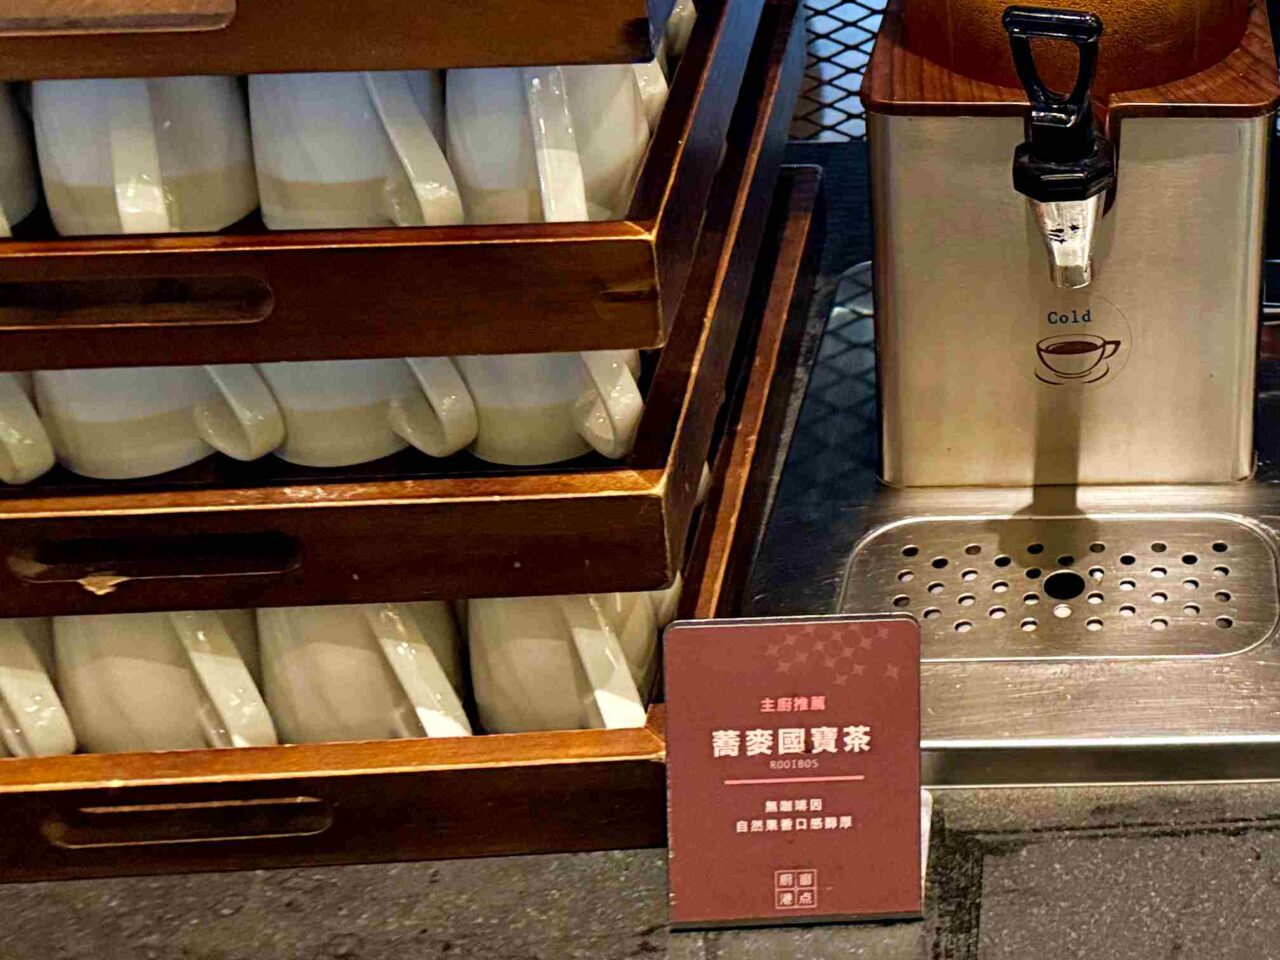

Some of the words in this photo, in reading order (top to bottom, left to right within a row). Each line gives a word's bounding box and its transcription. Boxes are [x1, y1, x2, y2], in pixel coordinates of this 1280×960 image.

[1047, 309, 1092, 325] Cold
[760, 695, 826, 713] 主廚推薦
[712, 725, 871, 758] 蕎麥國寶茶
[769, 758, 820, 770] ROOIBOS
[764, 798, 823, 813] 無咖啡因
[735, 815, 853, 833] 自然果香口感醇厚
